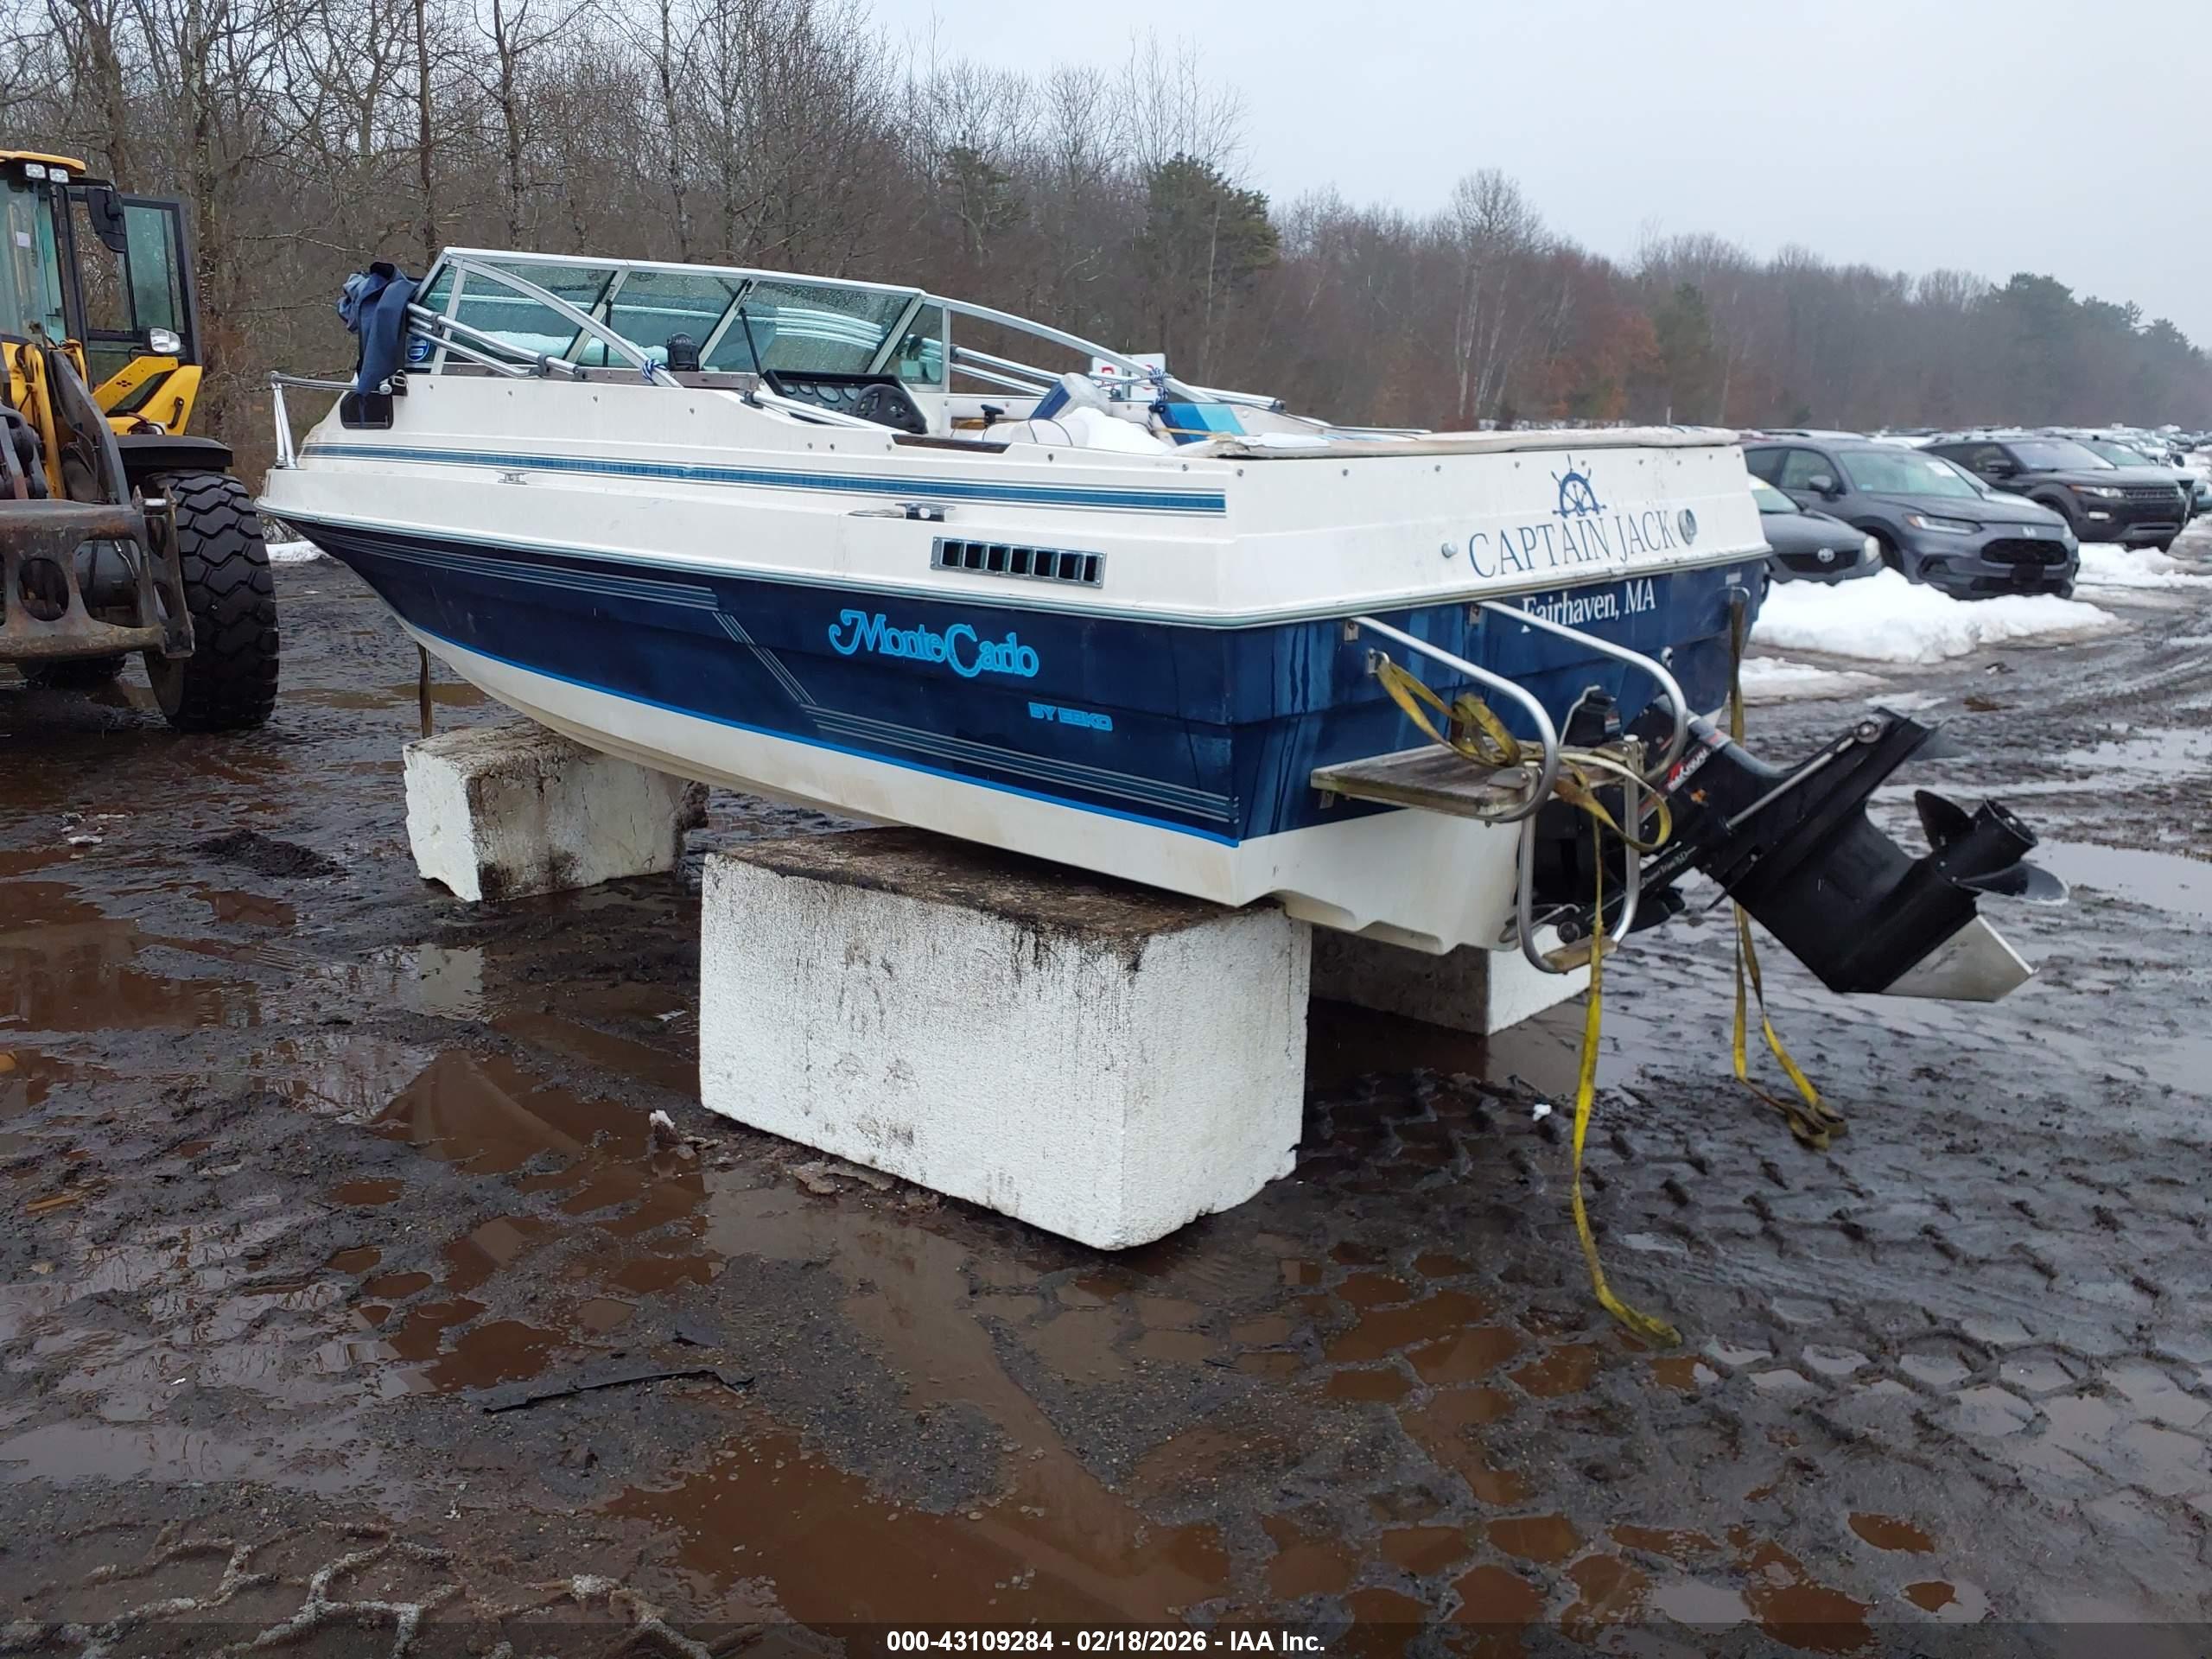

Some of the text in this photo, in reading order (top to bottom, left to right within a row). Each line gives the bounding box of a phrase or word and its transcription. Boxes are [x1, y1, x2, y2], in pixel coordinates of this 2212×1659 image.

[1468, 510, 1677, 579] CAPTAIN JACK
[1521, 577, 1656, 633] Fairhaven, MA
[1028, 702, 1058, 721] BY
